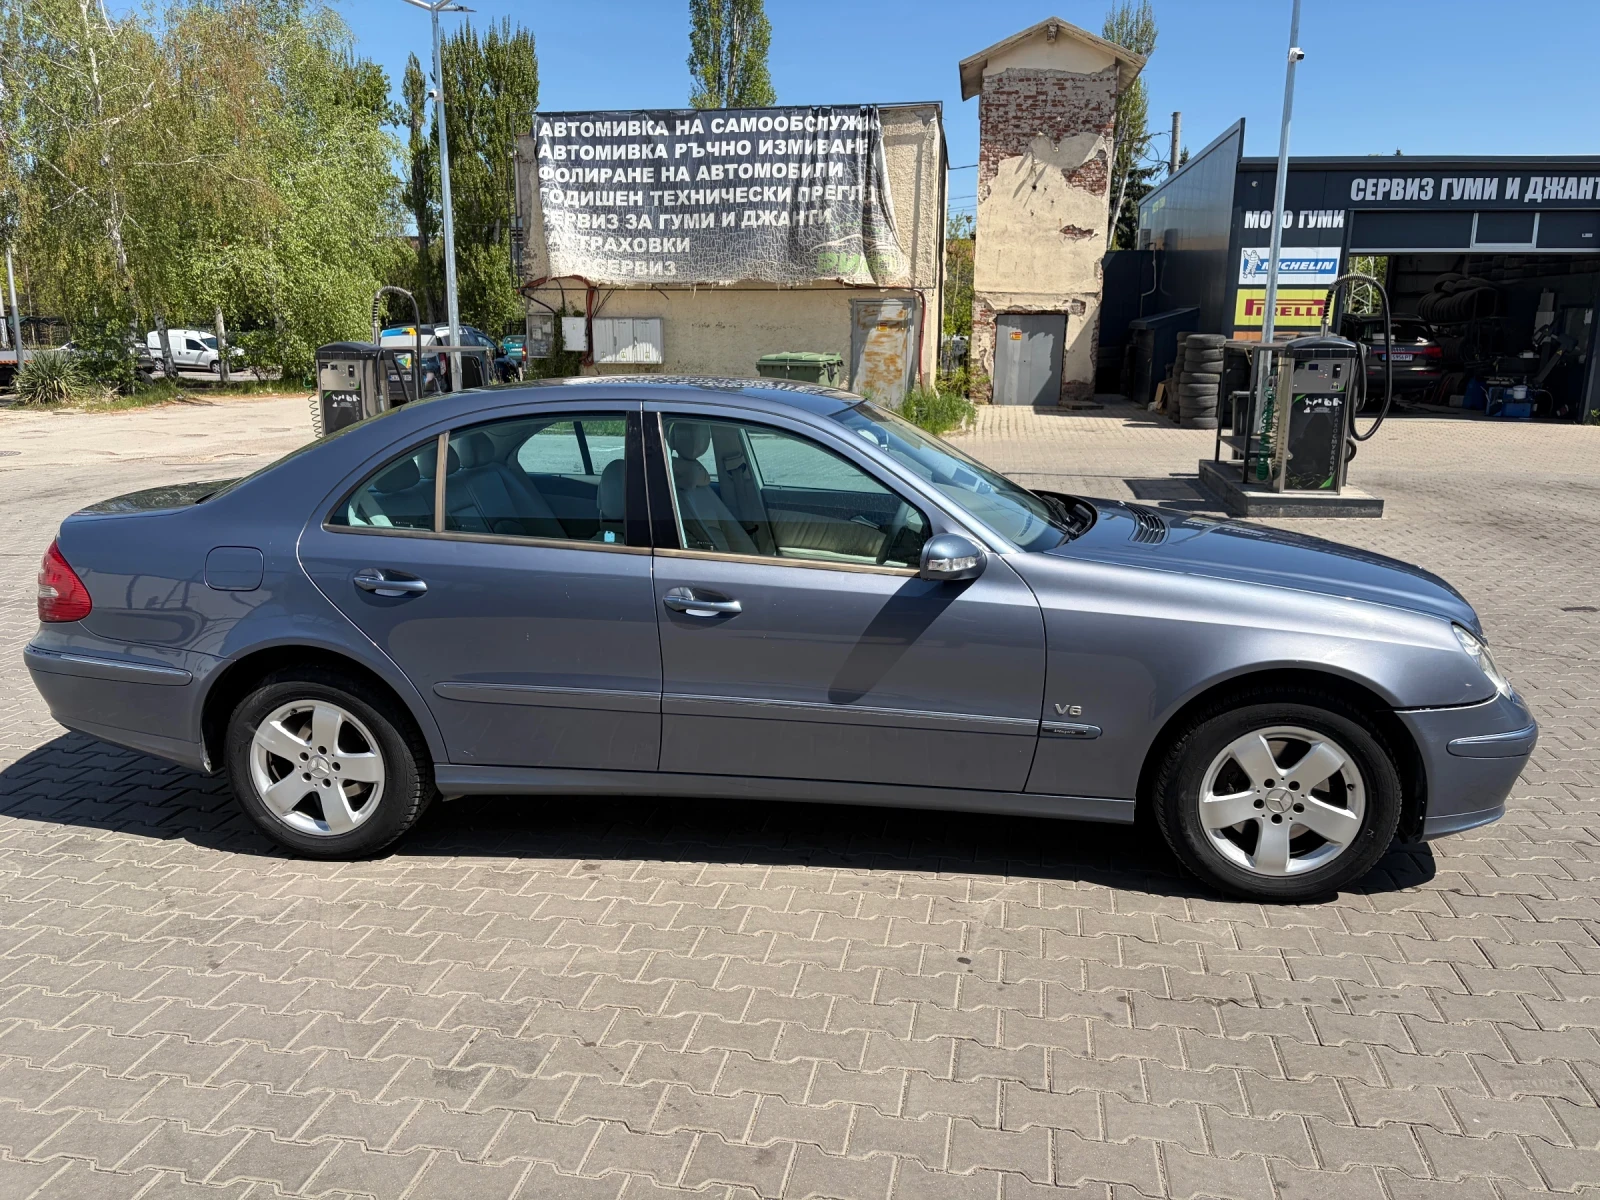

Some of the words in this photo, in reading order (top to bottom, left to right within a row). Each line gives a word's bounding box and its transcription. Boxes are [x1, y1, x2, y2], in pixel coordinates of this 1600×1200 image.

[539, 120, 669, 137] АВТОМИВКА
[675, 119, 704, 135] НА
[538, 143, 668, 160] АВТОМИВКА
[675, 140, 751, 158] РЪЧНО
[759, 138, 868, 155] ИЗМИВАНЕ
[539, 166, 654, 183] ФОЛИРАНЕ
[661, 166, 690, 182] НА
[696, 162, 843, 181] АВТОМОБИЛИ
[540, 188, 643, 208] ГОДИШЕН
[650, 186, 791, 206] ТЕХНИЧЕСКИ
[1350, 178, 1434, 201] СЕРВИЗ
[1440, 178, 1498, 200] ГУМИ
[1505, 177, 1521, 199] И
[625, 214, 652, 229] ЗА
[659, 213, 714, 230] ГУМИ
[722, 212, 735, 227] И
[741, 208, 832, 229] ДЖАНТИ
[1244, 210, 1293, 228] МОО
[1298, 210, 1345, 228] ГУМИ
[1055, 703, 1082, 716] V6
